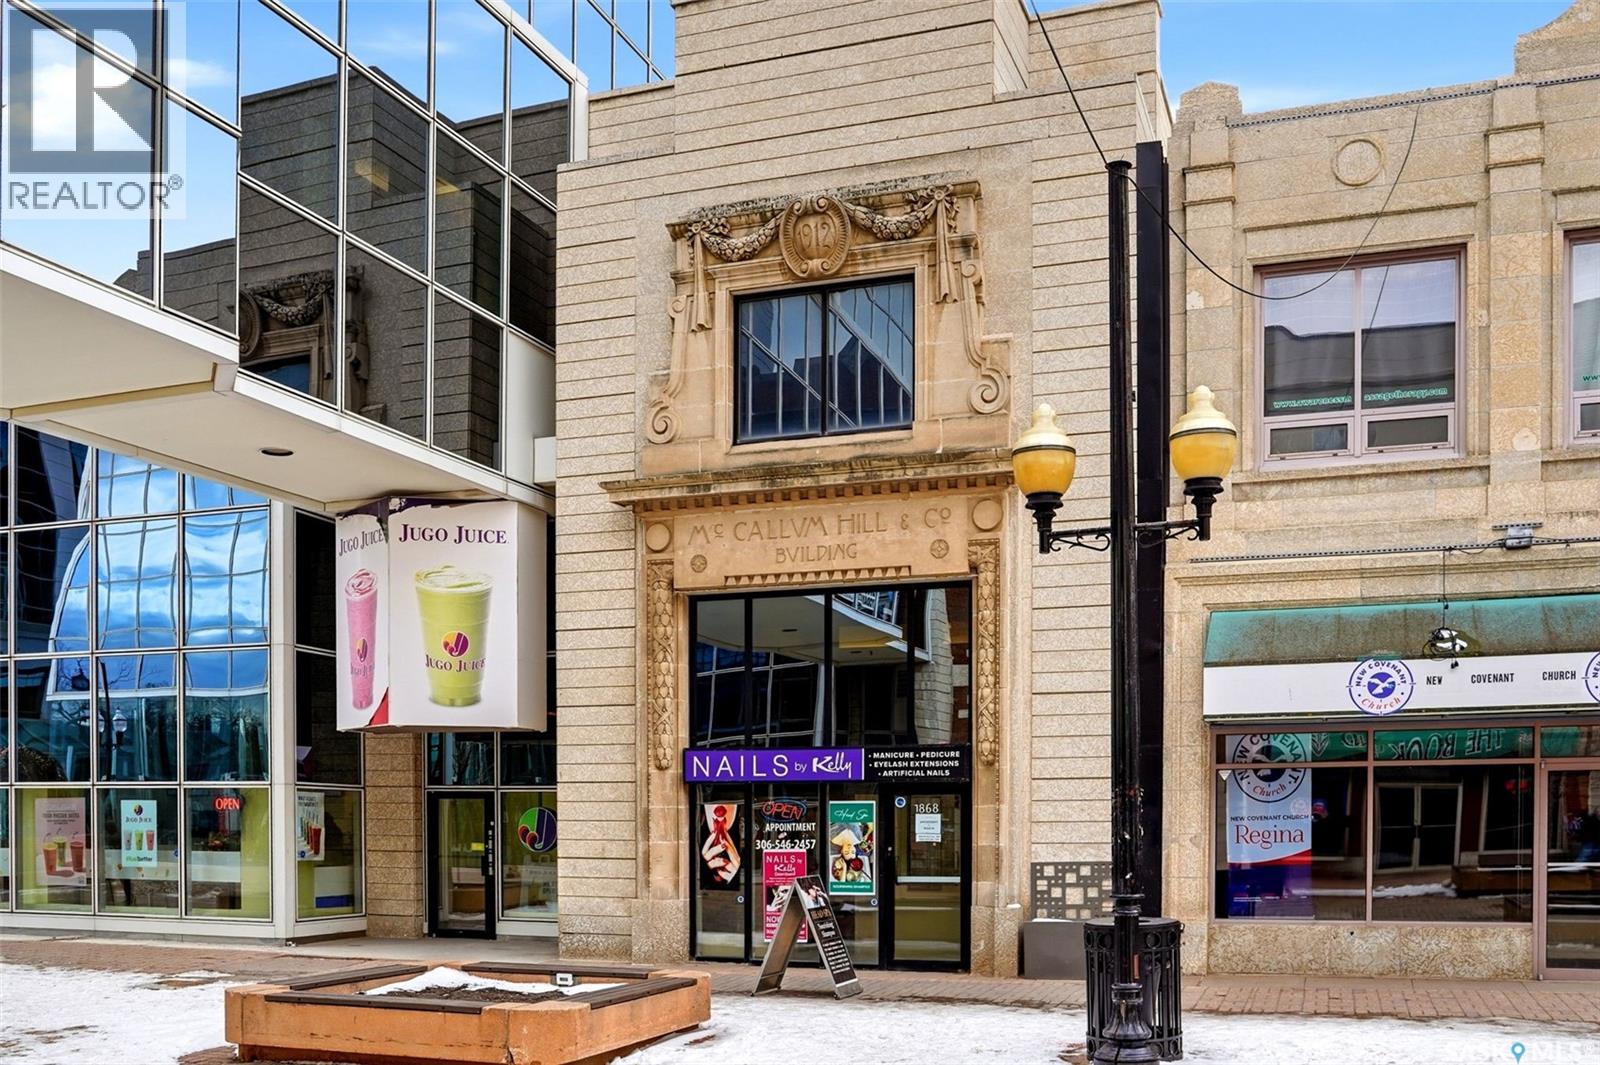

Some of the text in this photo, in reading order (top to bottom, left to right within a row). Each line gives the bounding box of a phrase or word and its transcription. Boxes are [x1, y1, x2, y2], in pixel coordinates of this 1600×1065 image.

[797, 222, 831, 252] 1912
[837, 511, 887, 536] HILL
[899, 513, 910, 530] &
[399, 523, 507, 545] JUGO JUICE
[338, 528, 385, 557] JUGO JUICE
[425, 654, 453, 671] JUGO
[1355, 661, 1407, 687] NEW COVENANT
[1426, 670, 1577, 686] NEW COVENANT CHURCH
[1361, 697, 1401, 710] Church
[693, 752, 852, 779] NAILS by Kelly
[882, 769, 925, 777] ARTIFICIAL
[1253, 783, 1287, 797] Church
[215, 797, 240, 811] OPEN
[762, 802, 803, 820] OPEN
[914, 803, 939, 813] 1868
[765, 822, 816, 832] APPOINTMENT
[755, 839, 816, 850] 306-546-2457
[1235, 824, 1304, 850] Regina
[766, 855, 796, 863] NAILS
[774, 864, 796, 872] Kelly
